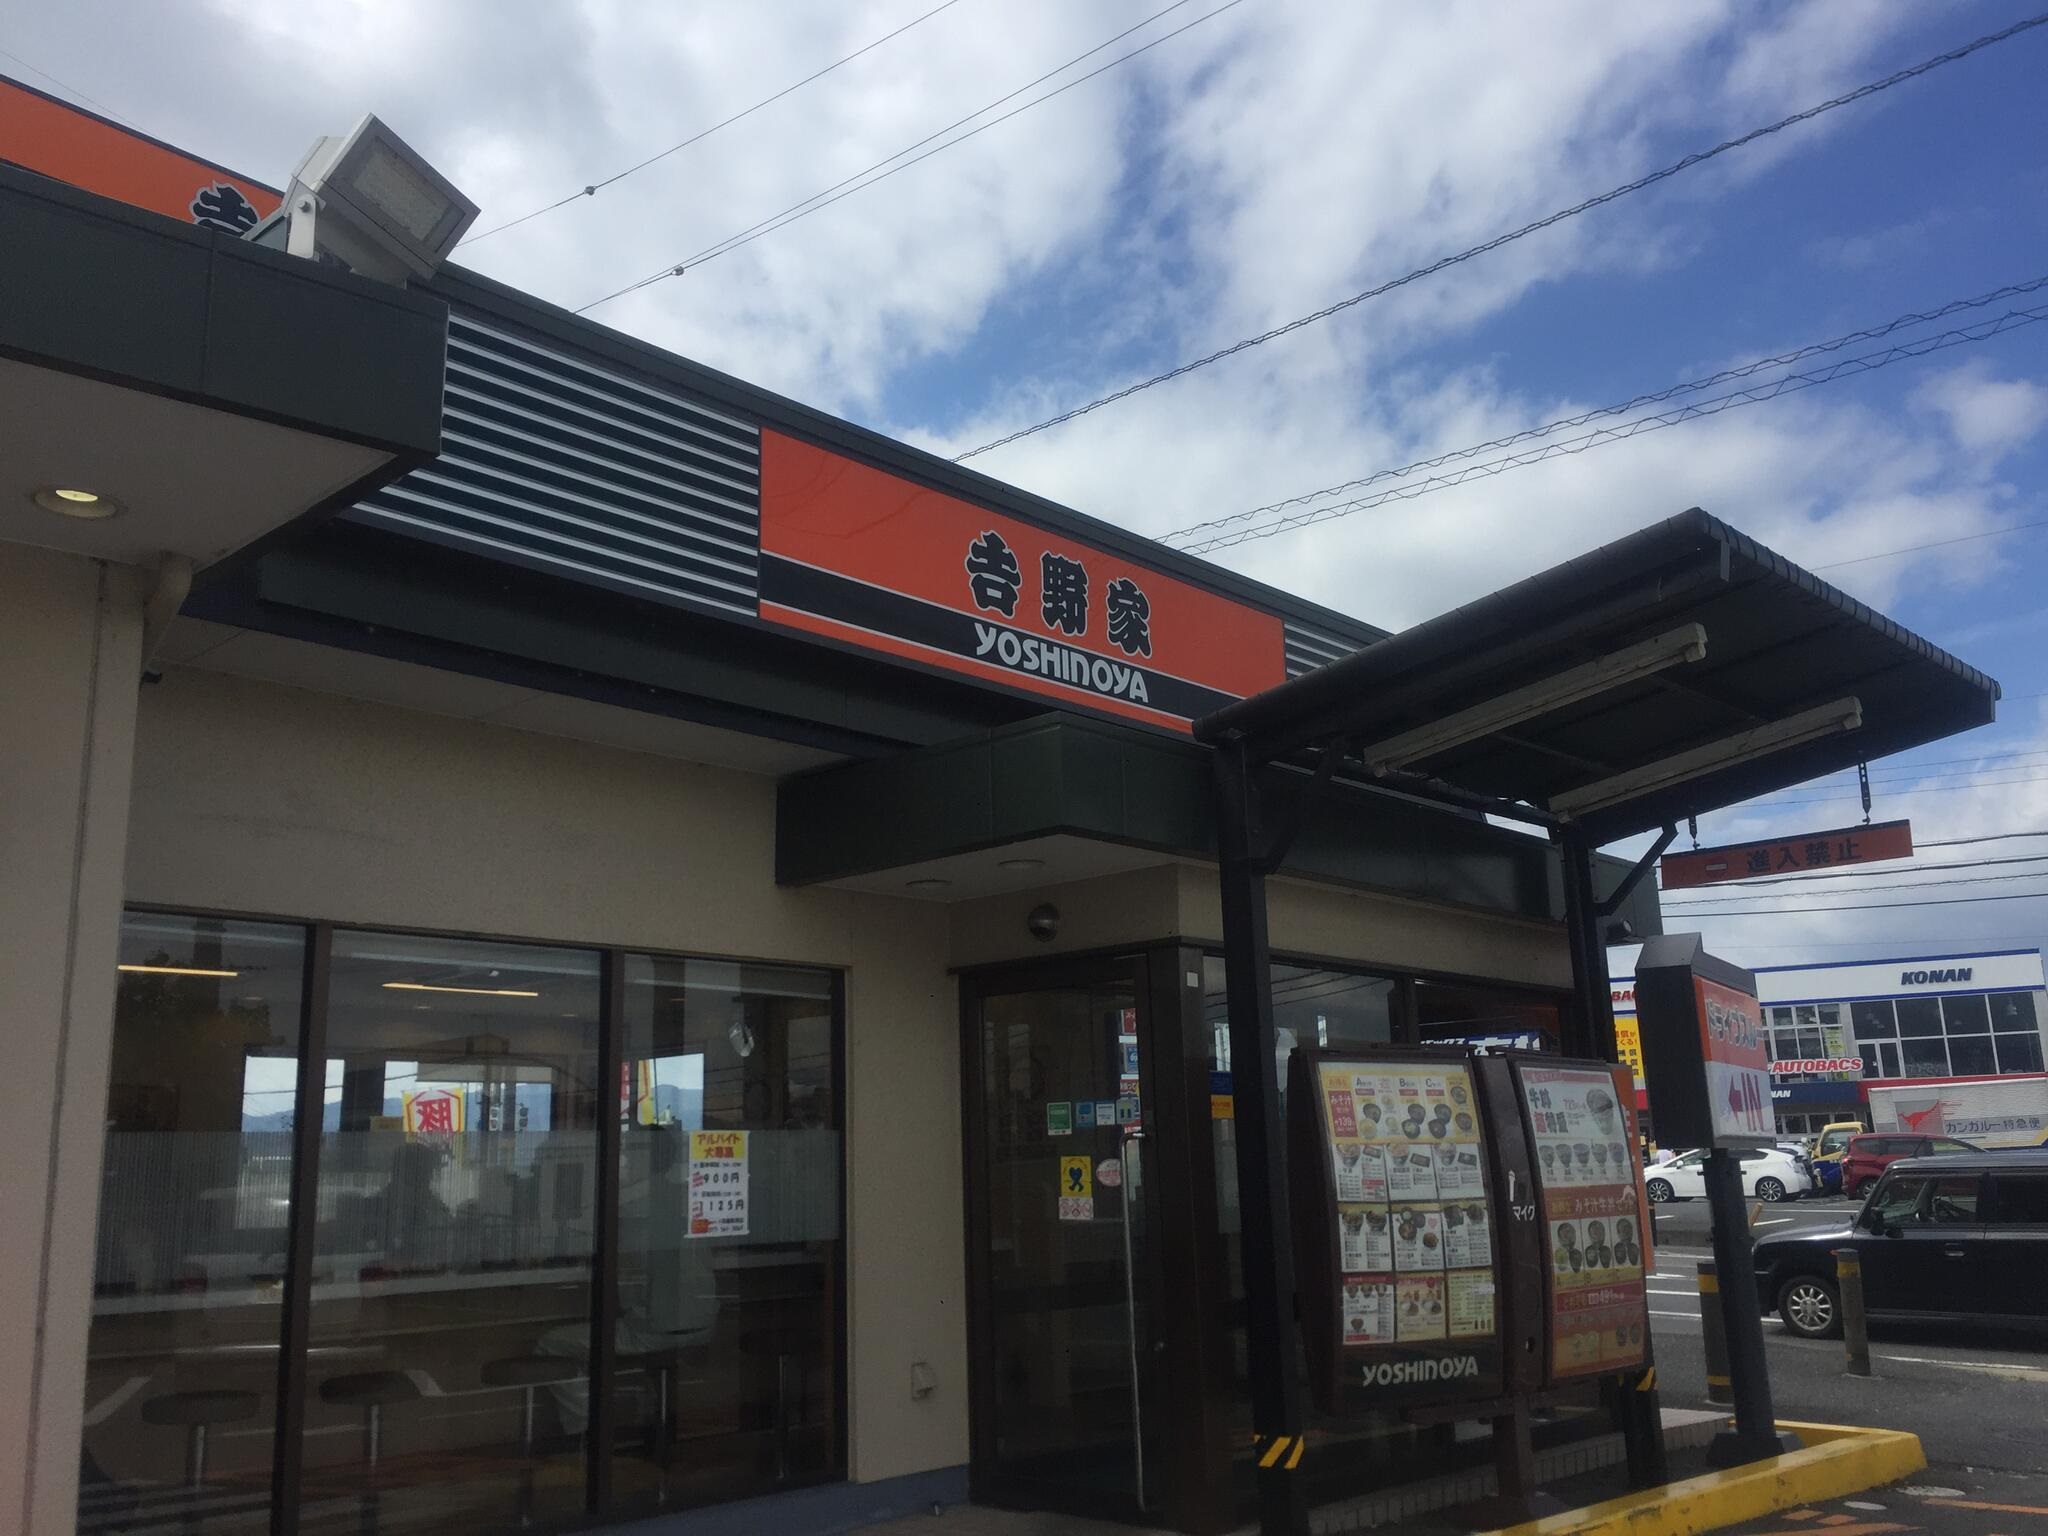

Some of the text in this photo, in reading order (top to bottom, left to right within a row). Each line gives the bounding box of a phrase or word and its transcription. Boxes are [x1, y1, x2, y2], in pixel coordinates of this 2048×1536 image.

[965, 530, 1152, 658] 吉野家
[975, 622, 1149, 704] YOSHINOYA
[1747, 838, 1863, 873] 進入禁止
[1901, 967, 1973, 985] KONAN
[1706, 998, 1764, 1050] ドライブスルー
[1771, 1057, 1863, 1074] AUTOBACS
[1740, 1072, 1765, 1132] IN
[696, 1133, 741, 1145] アルバイト
[1512, 1205, 1536, 1221] マイク
[1362, 1356, 1479, 1387] YOSHINOYA
